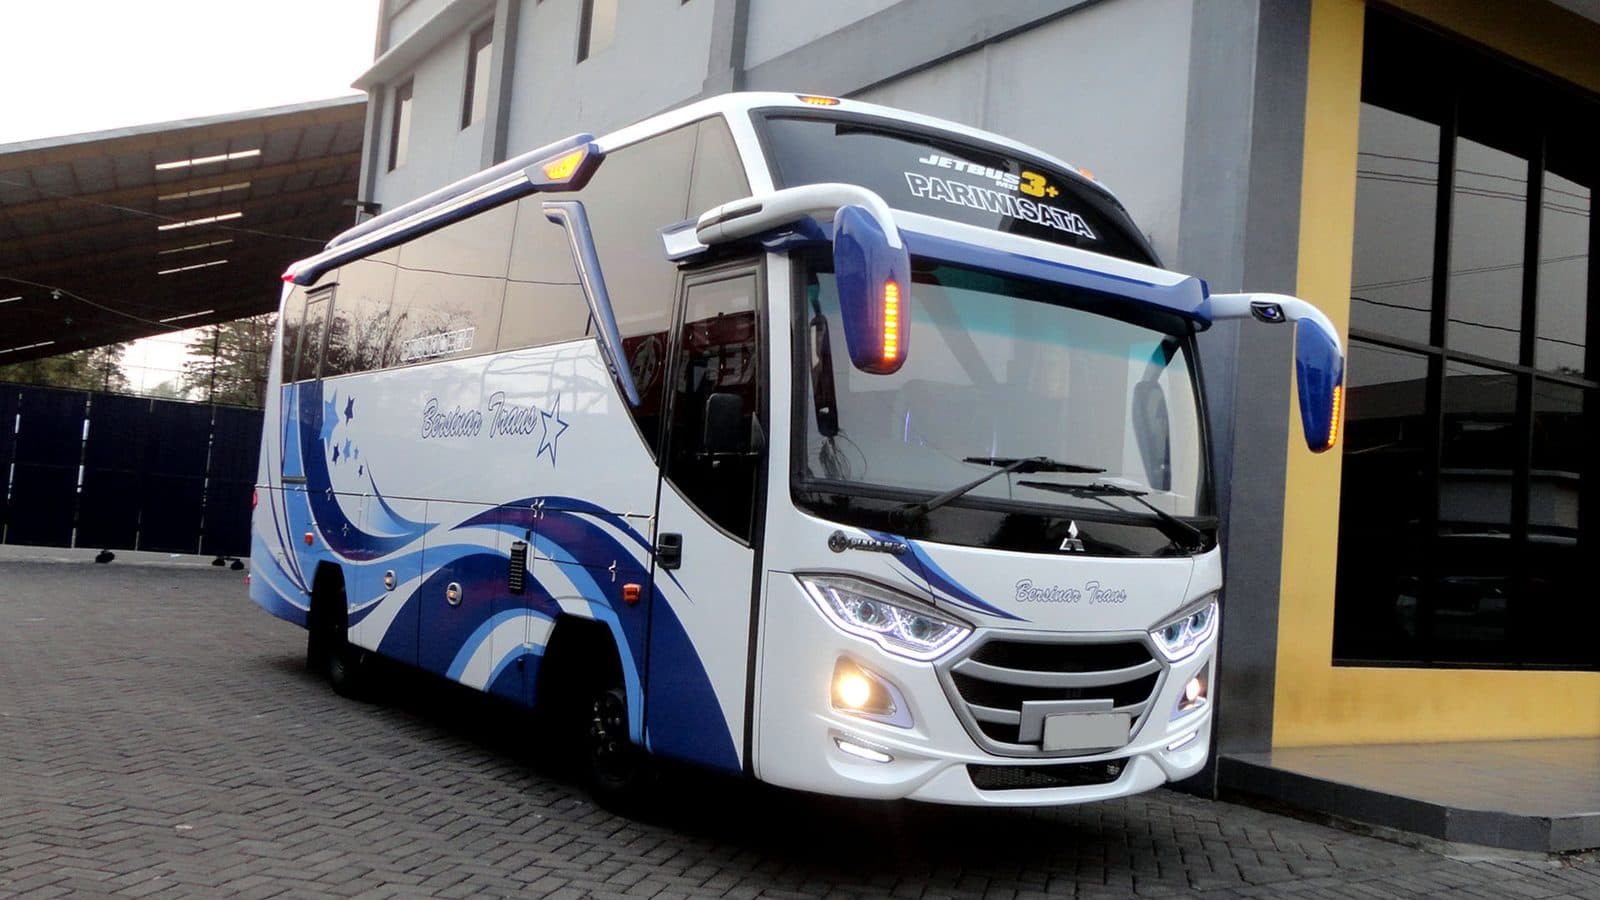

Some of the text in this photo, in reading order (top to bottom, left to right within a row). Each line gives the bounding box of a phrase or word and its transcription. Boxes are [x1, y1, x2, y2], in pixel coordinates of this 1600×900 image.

[919, 154, 1059, 198] JETBUS 3+
[904, 172, 1097, 239] PARIWISATA
[421, 391, 538, 439] Bersinar Trans
[1015, 579, 1127, 605] Bersinar Trans
